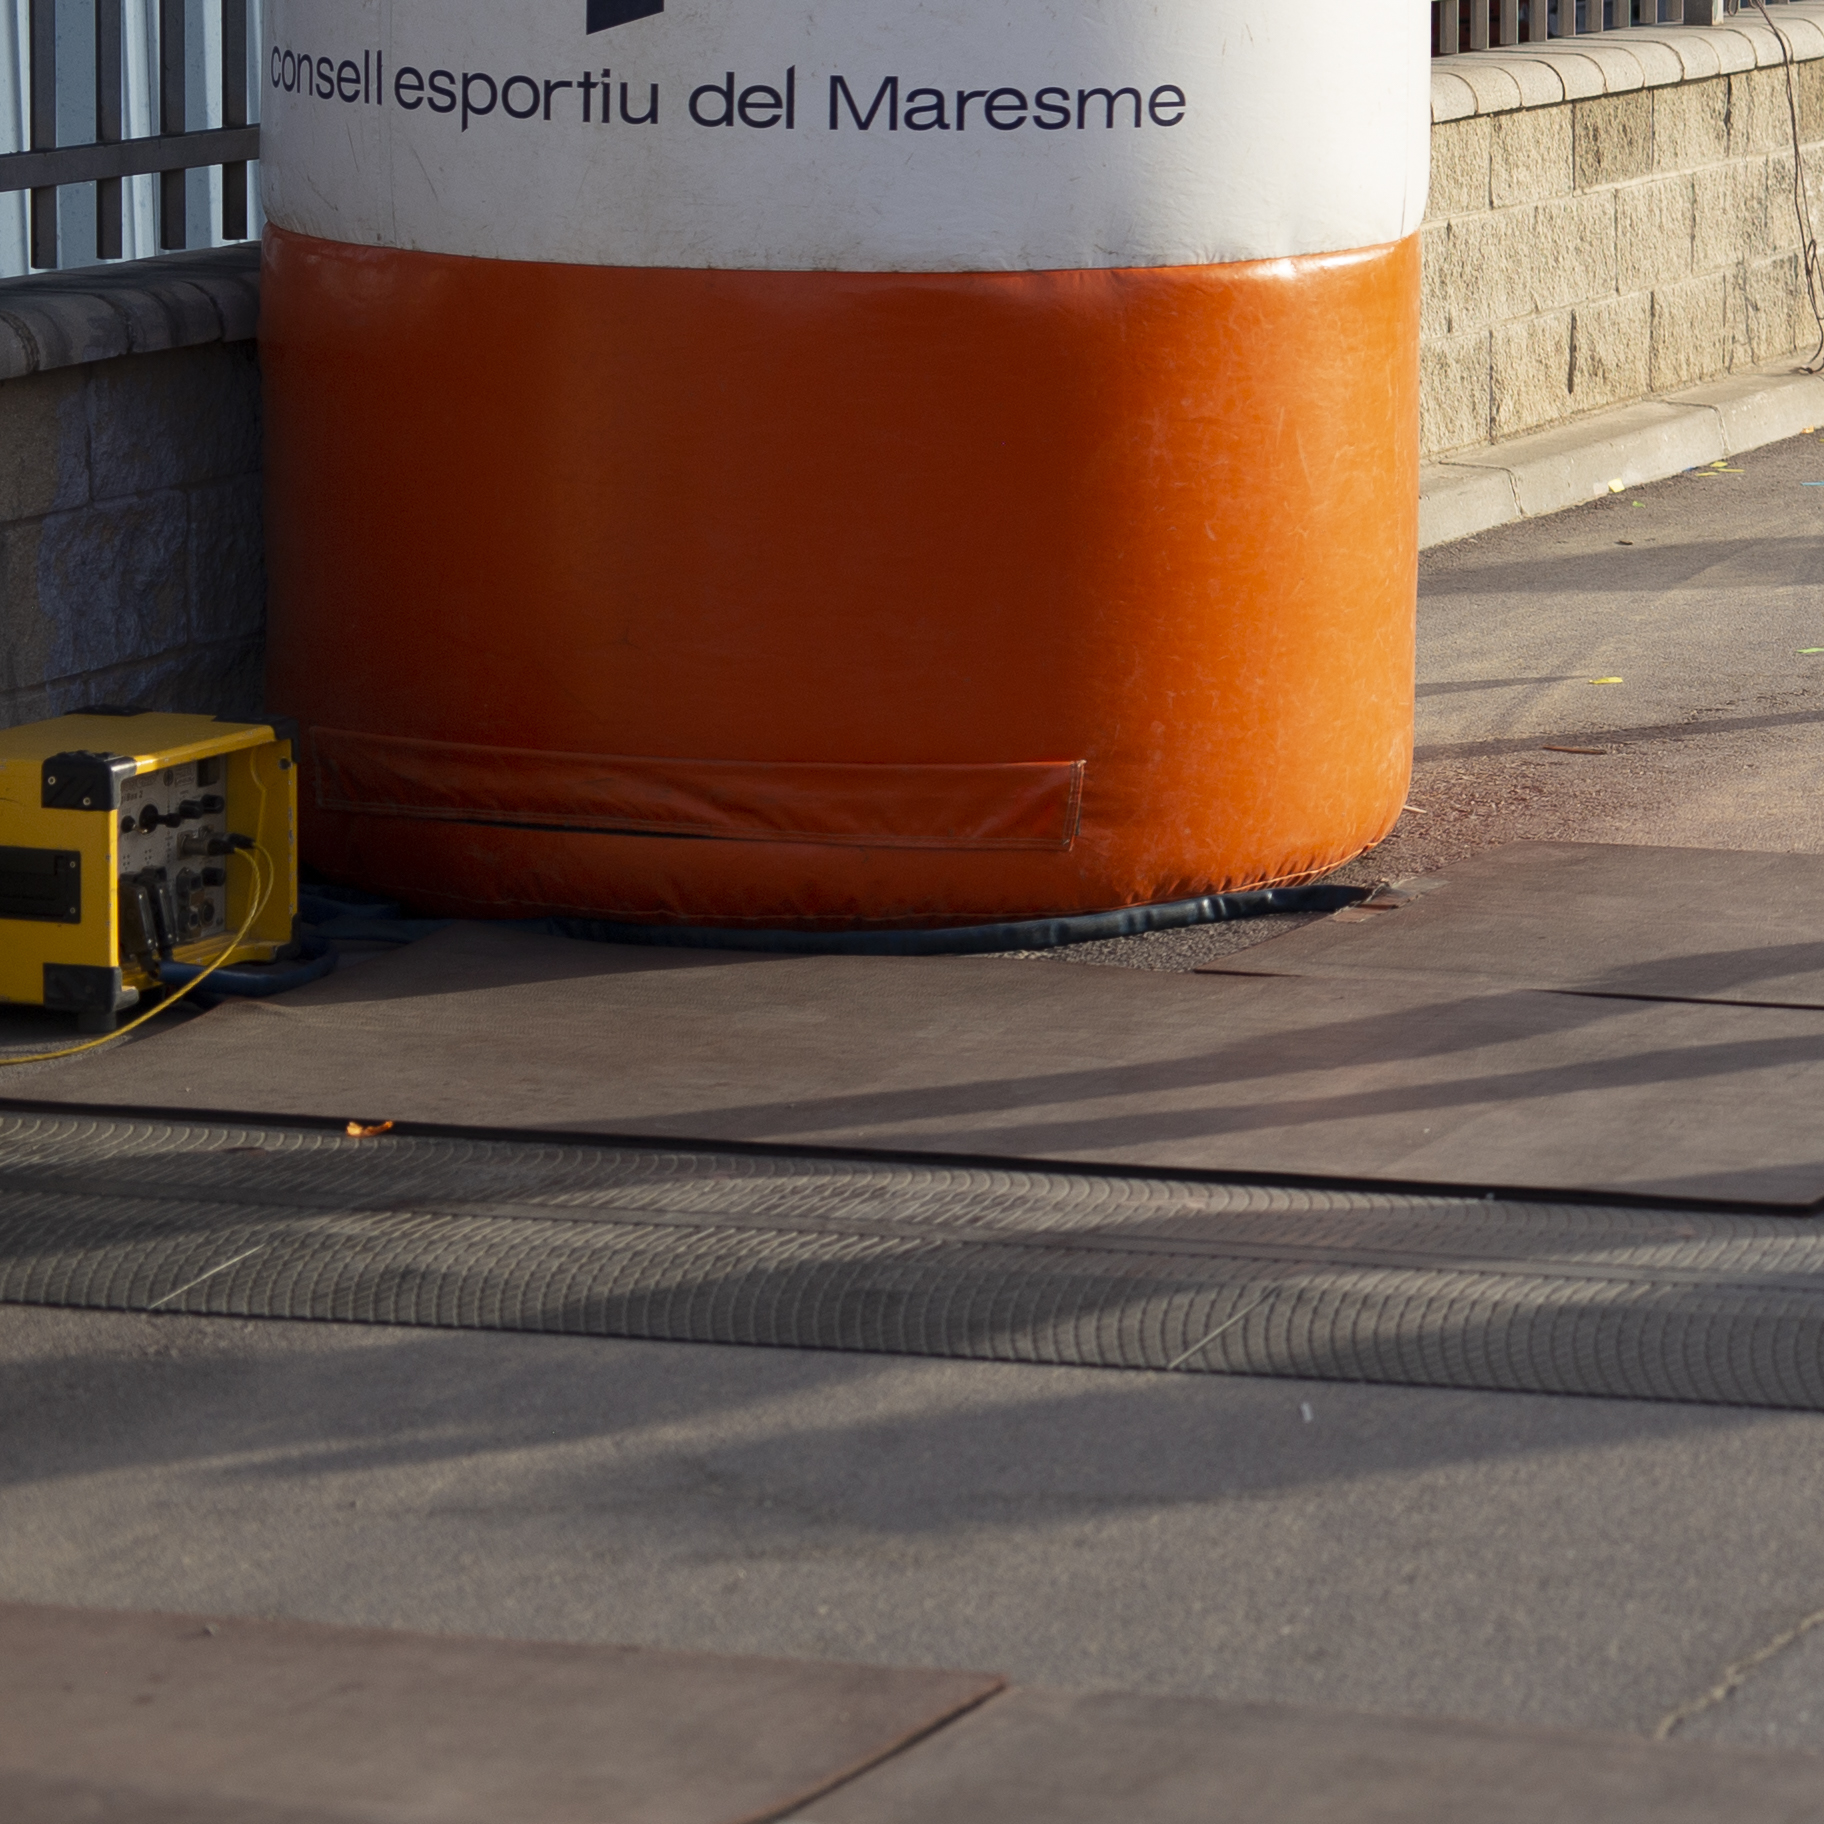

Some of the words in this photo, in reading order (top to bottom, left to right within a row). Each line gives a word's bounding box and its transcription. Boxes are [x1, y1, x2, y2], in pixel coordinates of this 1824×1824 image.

[270, 45, 383, 106] consell
[394, 67, 659, 133] esportiu
[688, 64, 796, 130] del
[828, 74, 1187, 132] Maresme
